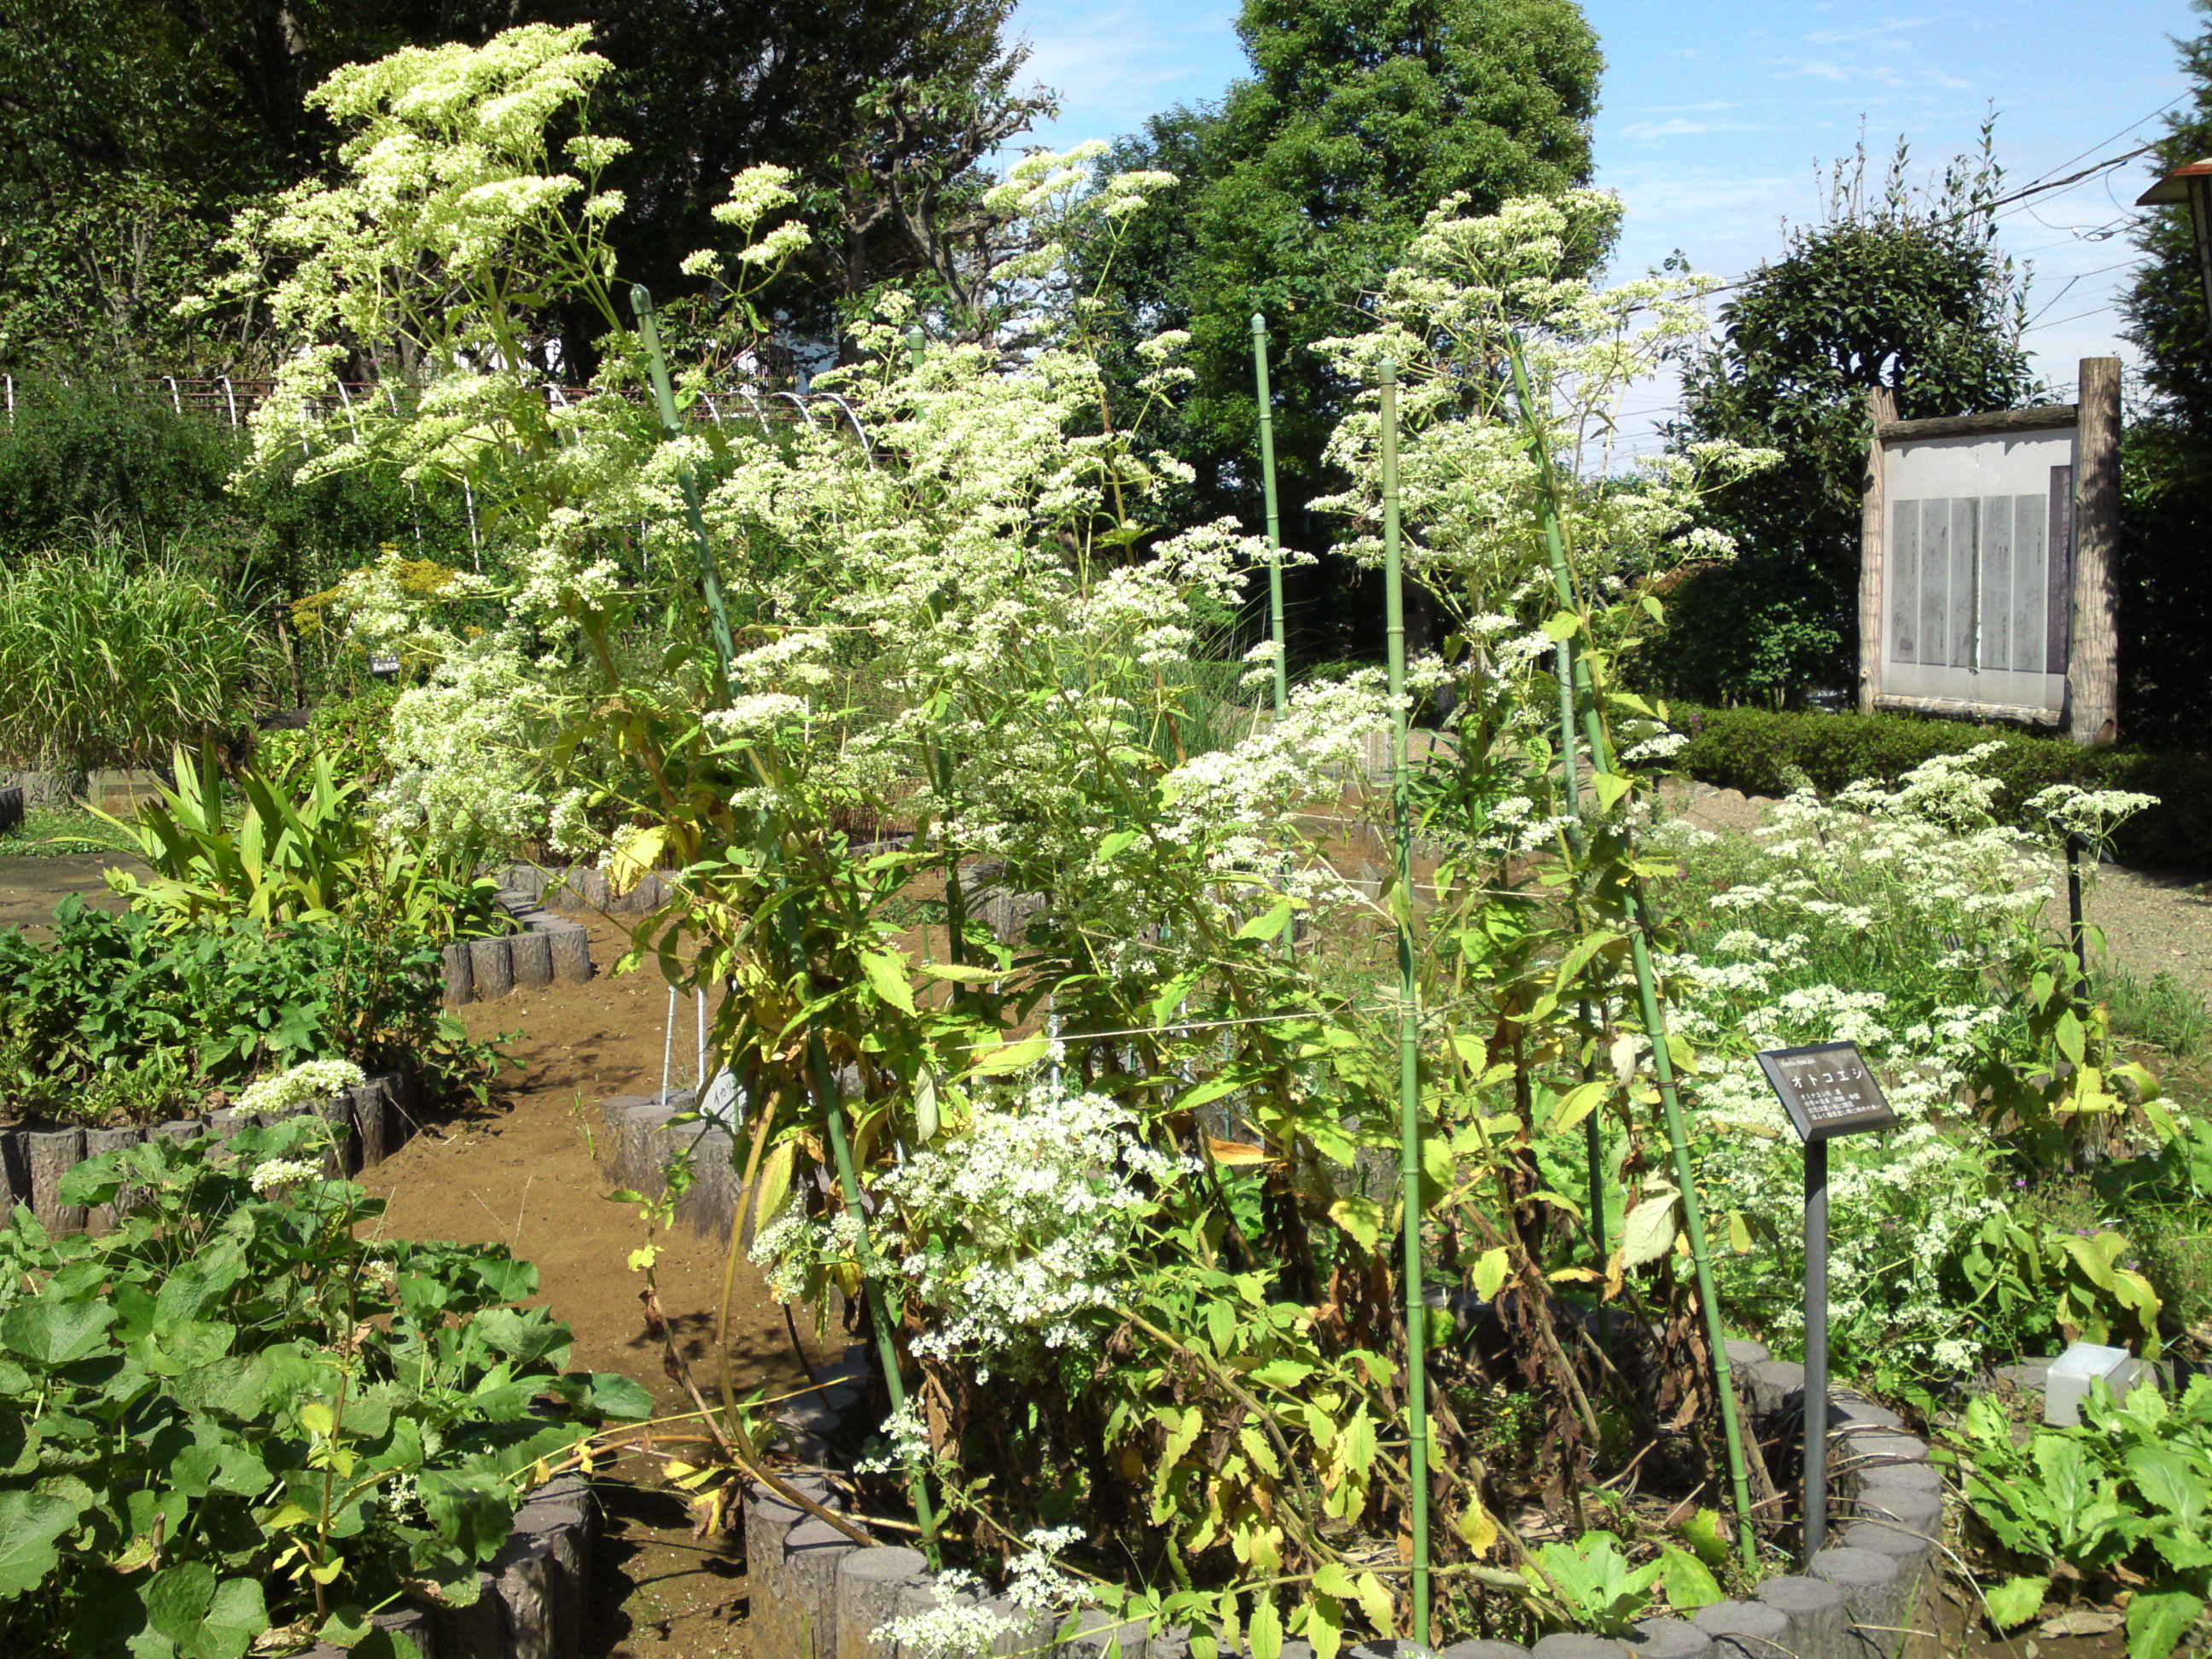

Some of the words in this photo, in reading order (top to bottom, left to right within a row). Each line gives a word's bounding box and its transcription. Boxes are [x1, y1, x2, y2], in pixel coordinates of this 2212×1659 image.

[1791, 1068, 1862, 1089] オトコエシ
